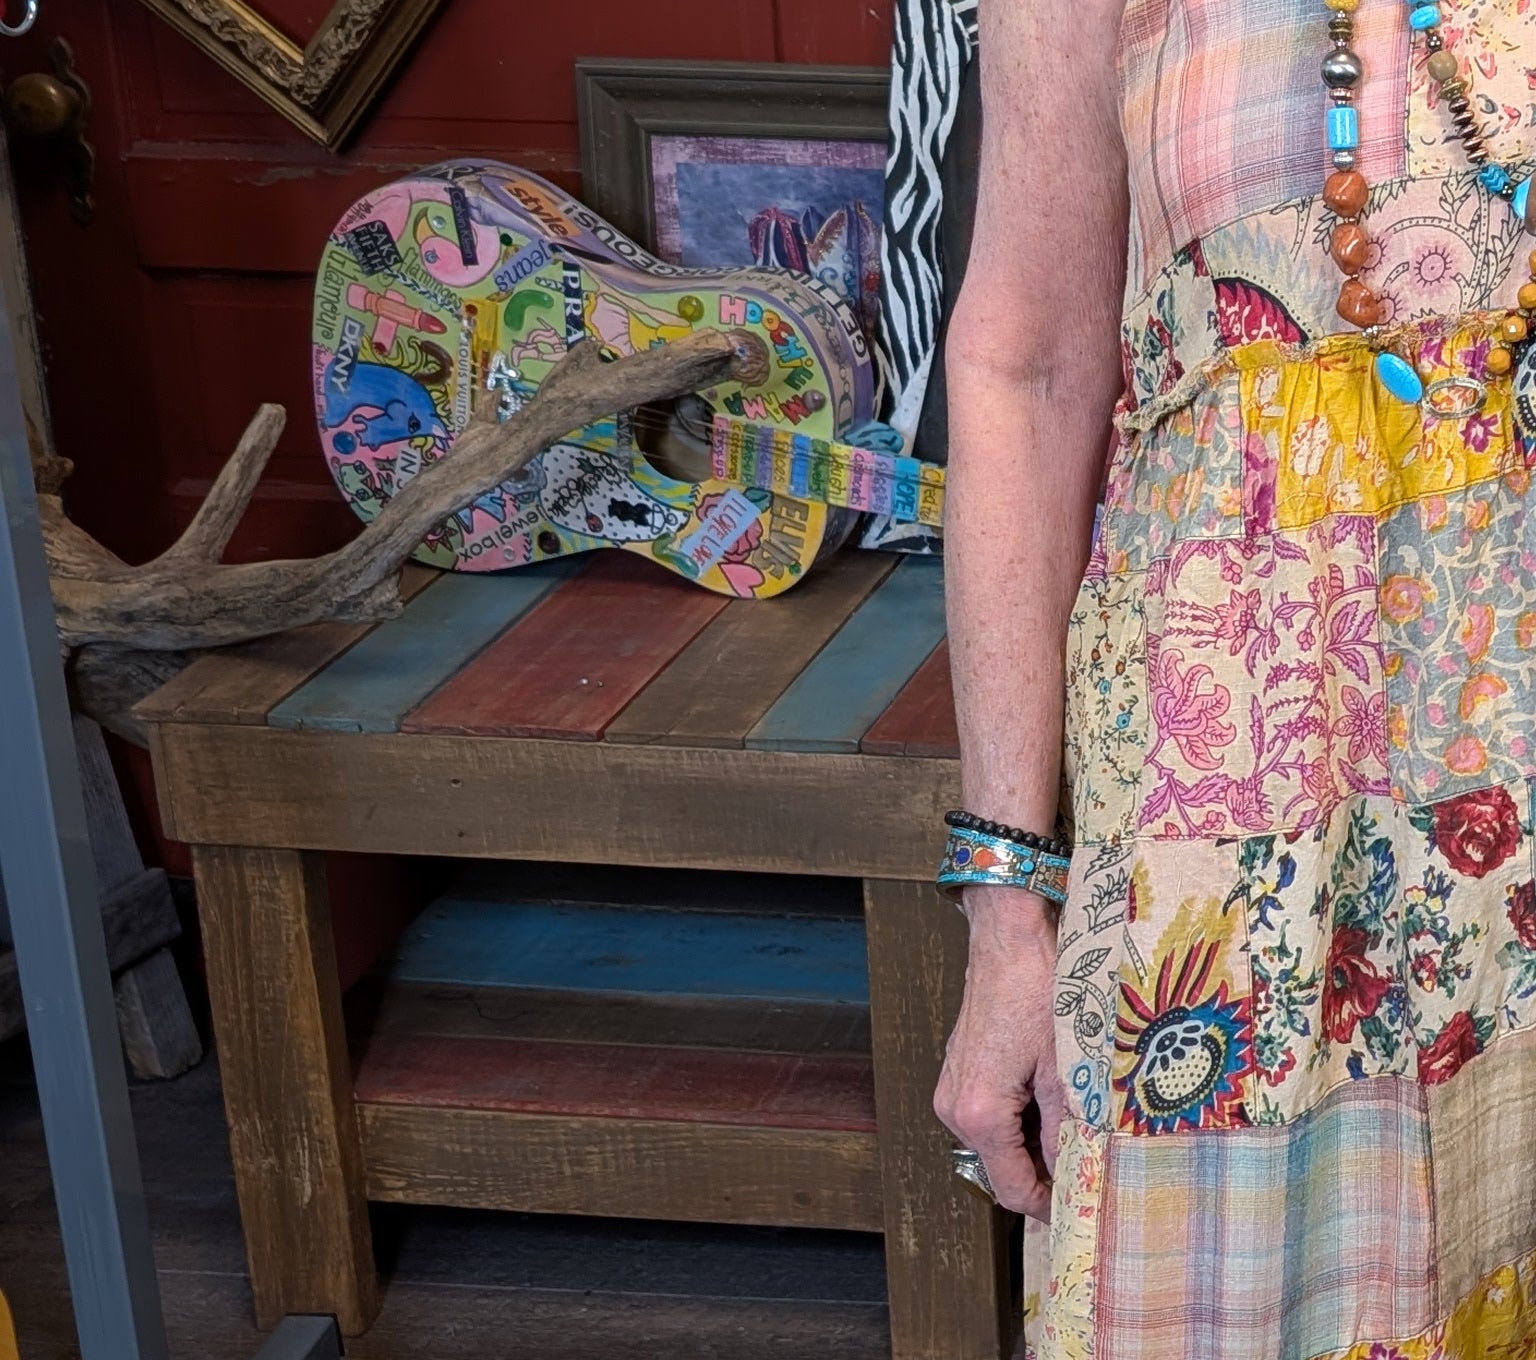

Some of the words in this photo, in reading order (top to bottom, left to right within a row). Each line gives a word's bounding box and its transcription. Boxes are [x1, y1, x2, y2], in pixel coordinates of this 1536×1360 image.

[355, 226, 385, 271] FIFTH
[369, 221, 399, 266] SAKS
[331, 320, 363, 393] DKNY
[752, 493, 810, 581] ELVIS
